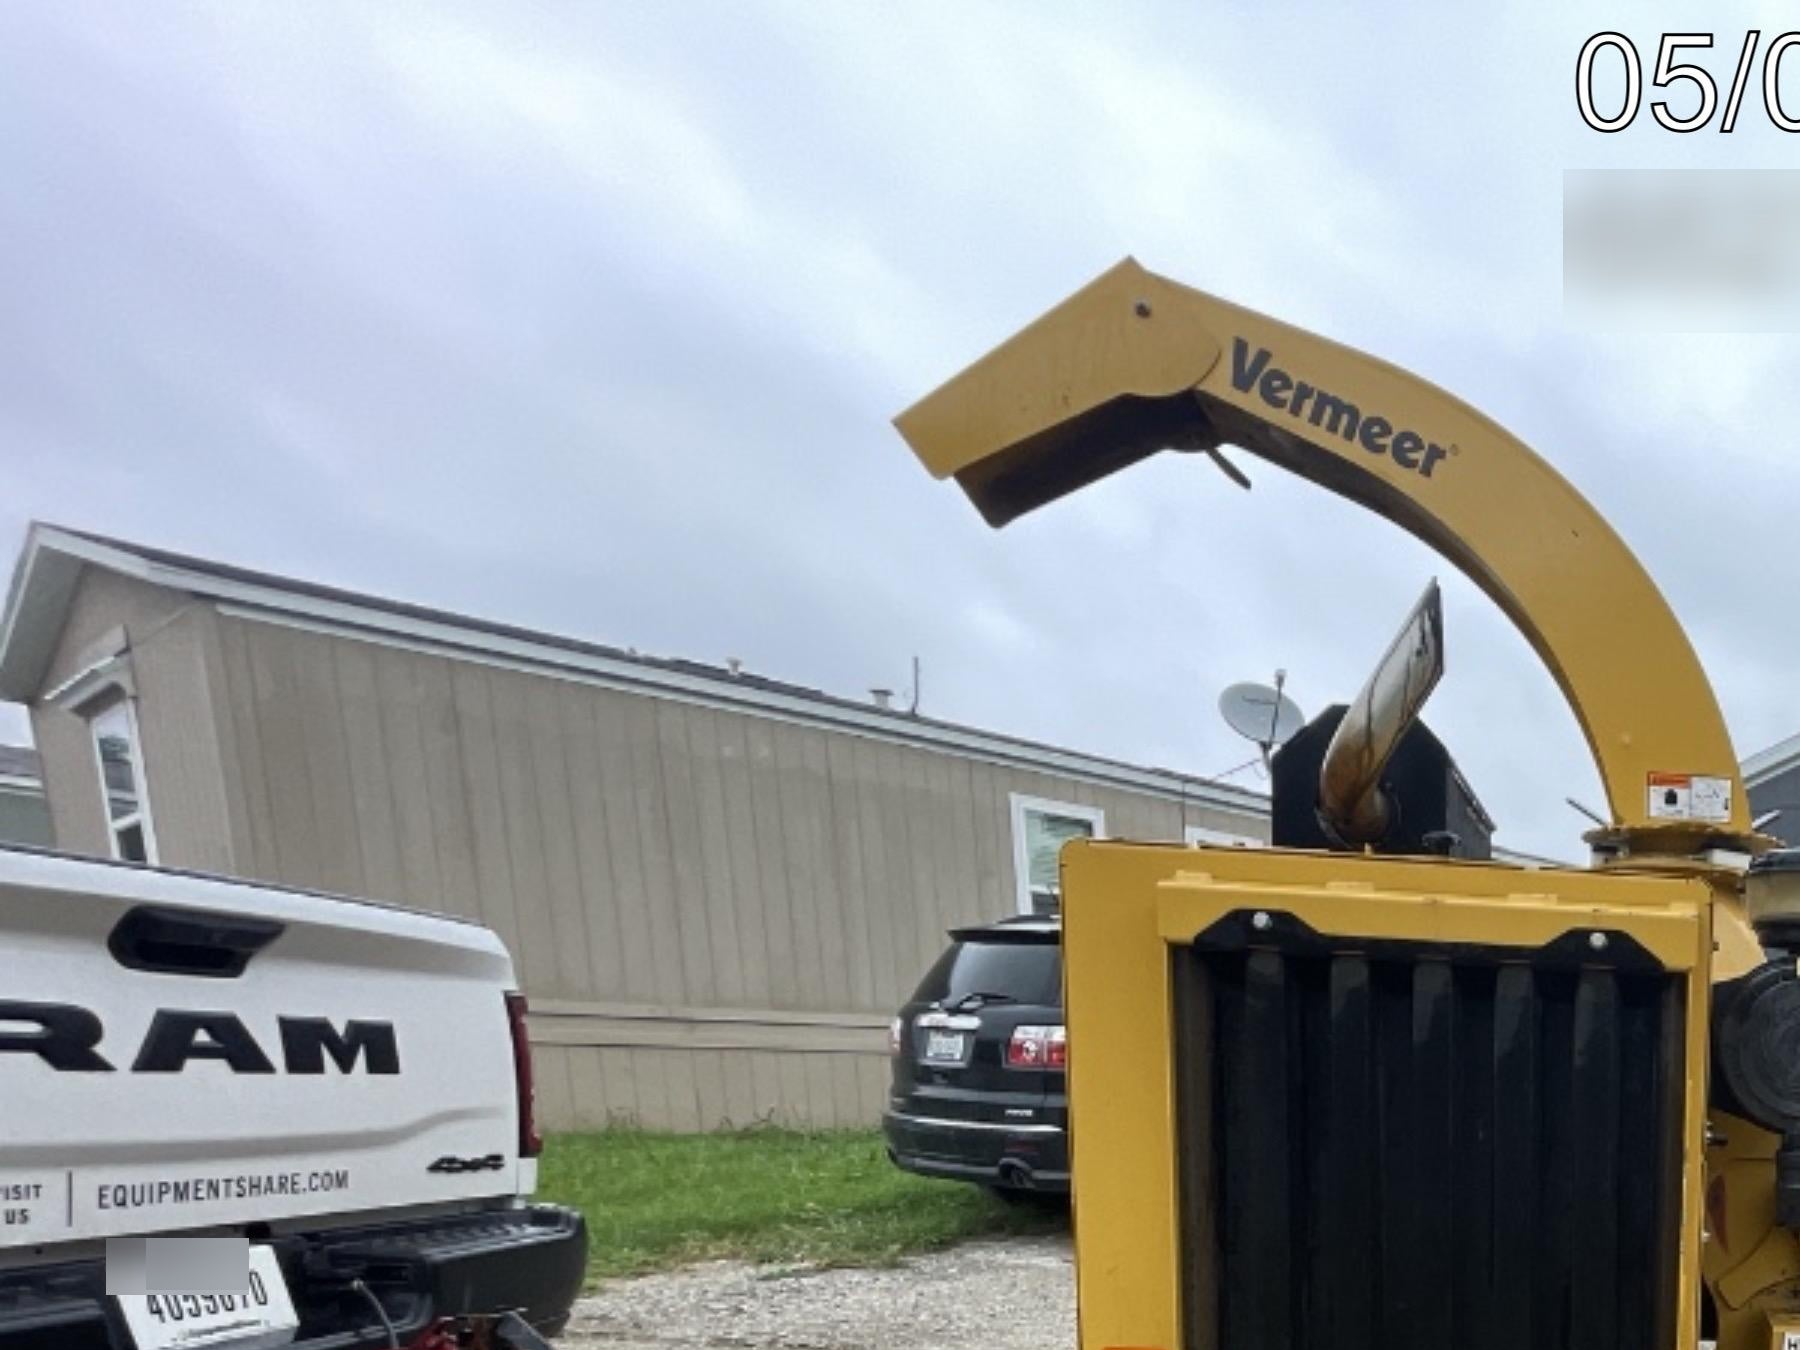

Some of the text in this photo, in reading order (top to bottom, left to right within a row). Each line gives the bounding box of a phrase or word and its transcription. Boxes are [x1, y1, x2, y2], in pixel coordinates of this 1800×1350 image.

[1232, 336, 1447, 478] Vermeer
[0, 999, 400, 1075] RAM
[5, 1207, 30, 1225] US
[98, 1169, 350, 1209] EQUIPMENTSHARE.COM
